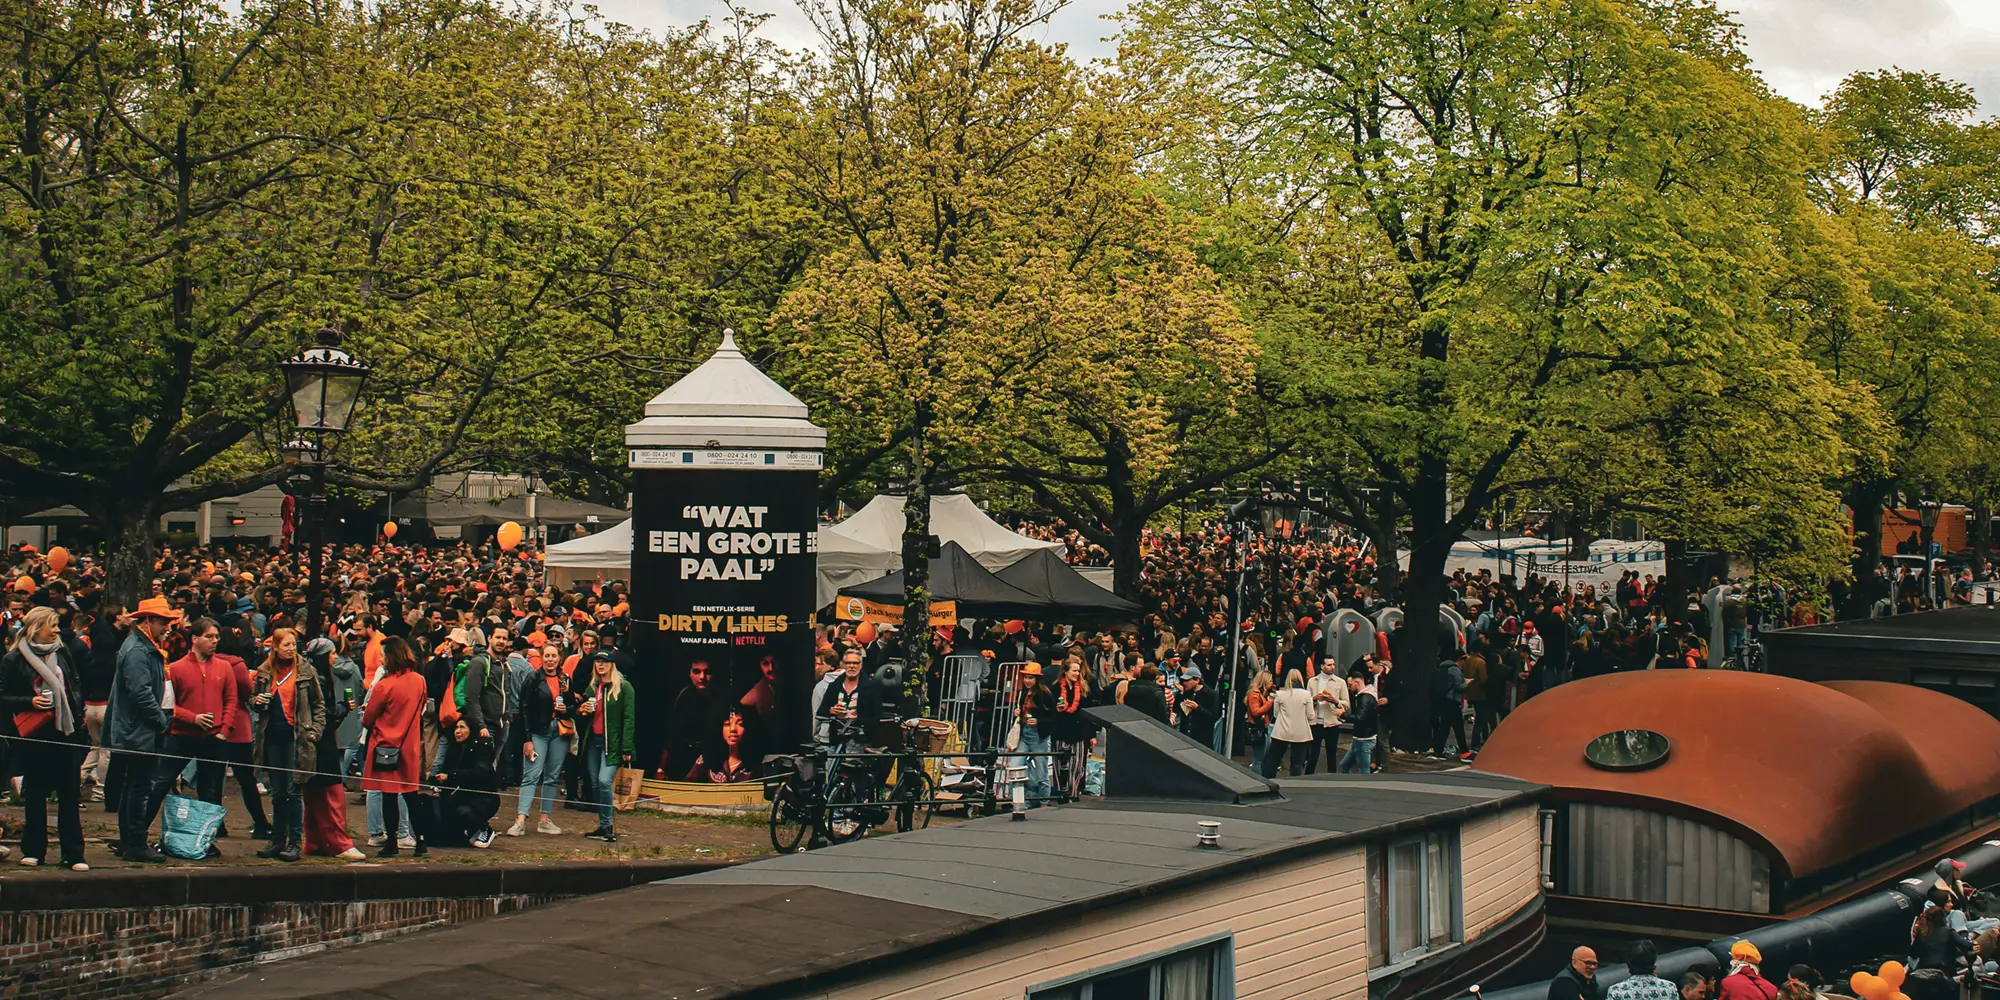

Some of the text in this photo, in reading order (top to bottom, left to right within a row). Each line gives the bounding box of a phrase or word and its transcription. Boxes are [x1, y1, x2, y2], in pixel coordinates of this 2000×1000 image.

[683, 505, 768, 528] “WAT
[649, 531, 801, 555] EEN GROTE
[680, 558, 775, 581] PAAL”
[1561, 565, 1604, 574] FESTIVAL
[866, 606, 884, 616] Black
[658, 614, 724, 633] DIRTY
[726, 615, 789, 633] LINES
[735, 636, 766, 646] NETFLIX
